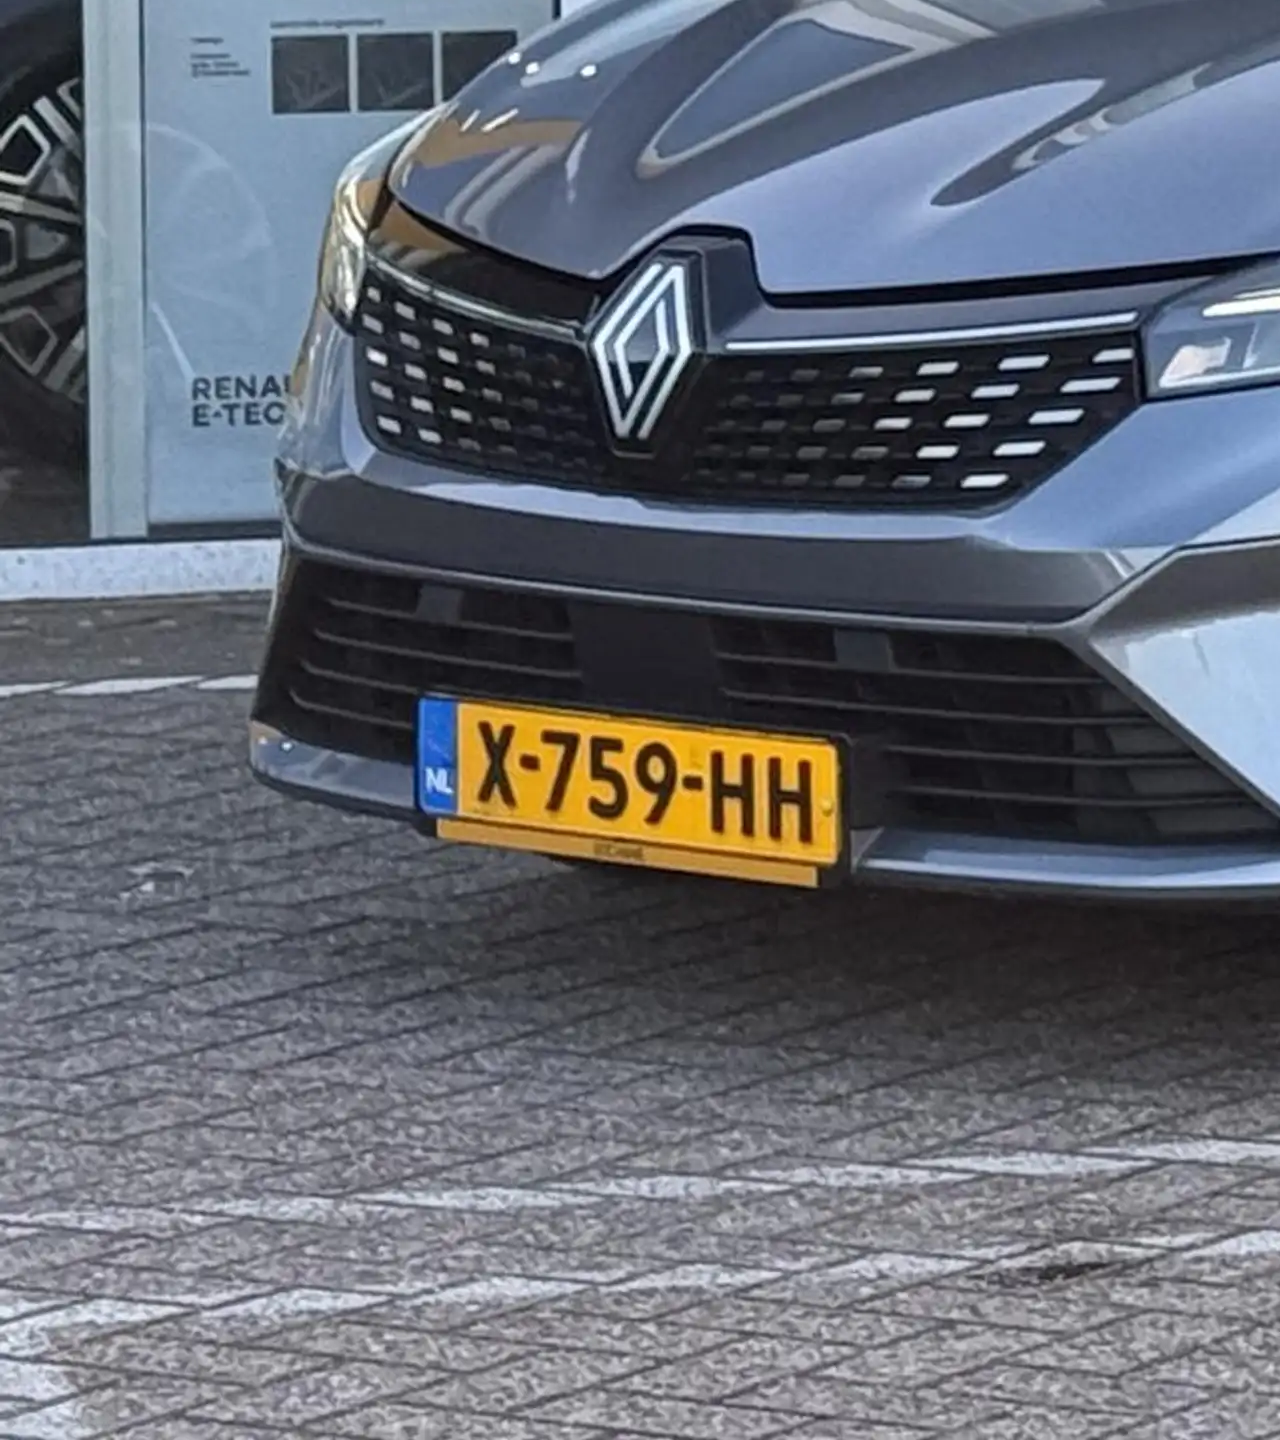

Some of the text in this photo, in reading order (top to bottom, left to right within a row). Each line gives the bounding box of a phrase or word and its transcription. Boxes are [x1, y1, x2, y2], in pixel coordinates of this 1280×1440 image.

[192, 401, 287, 427] E-TEC
[425, 767, 453, 795] NL
[477, 720, 814, 844] X-759-HH
